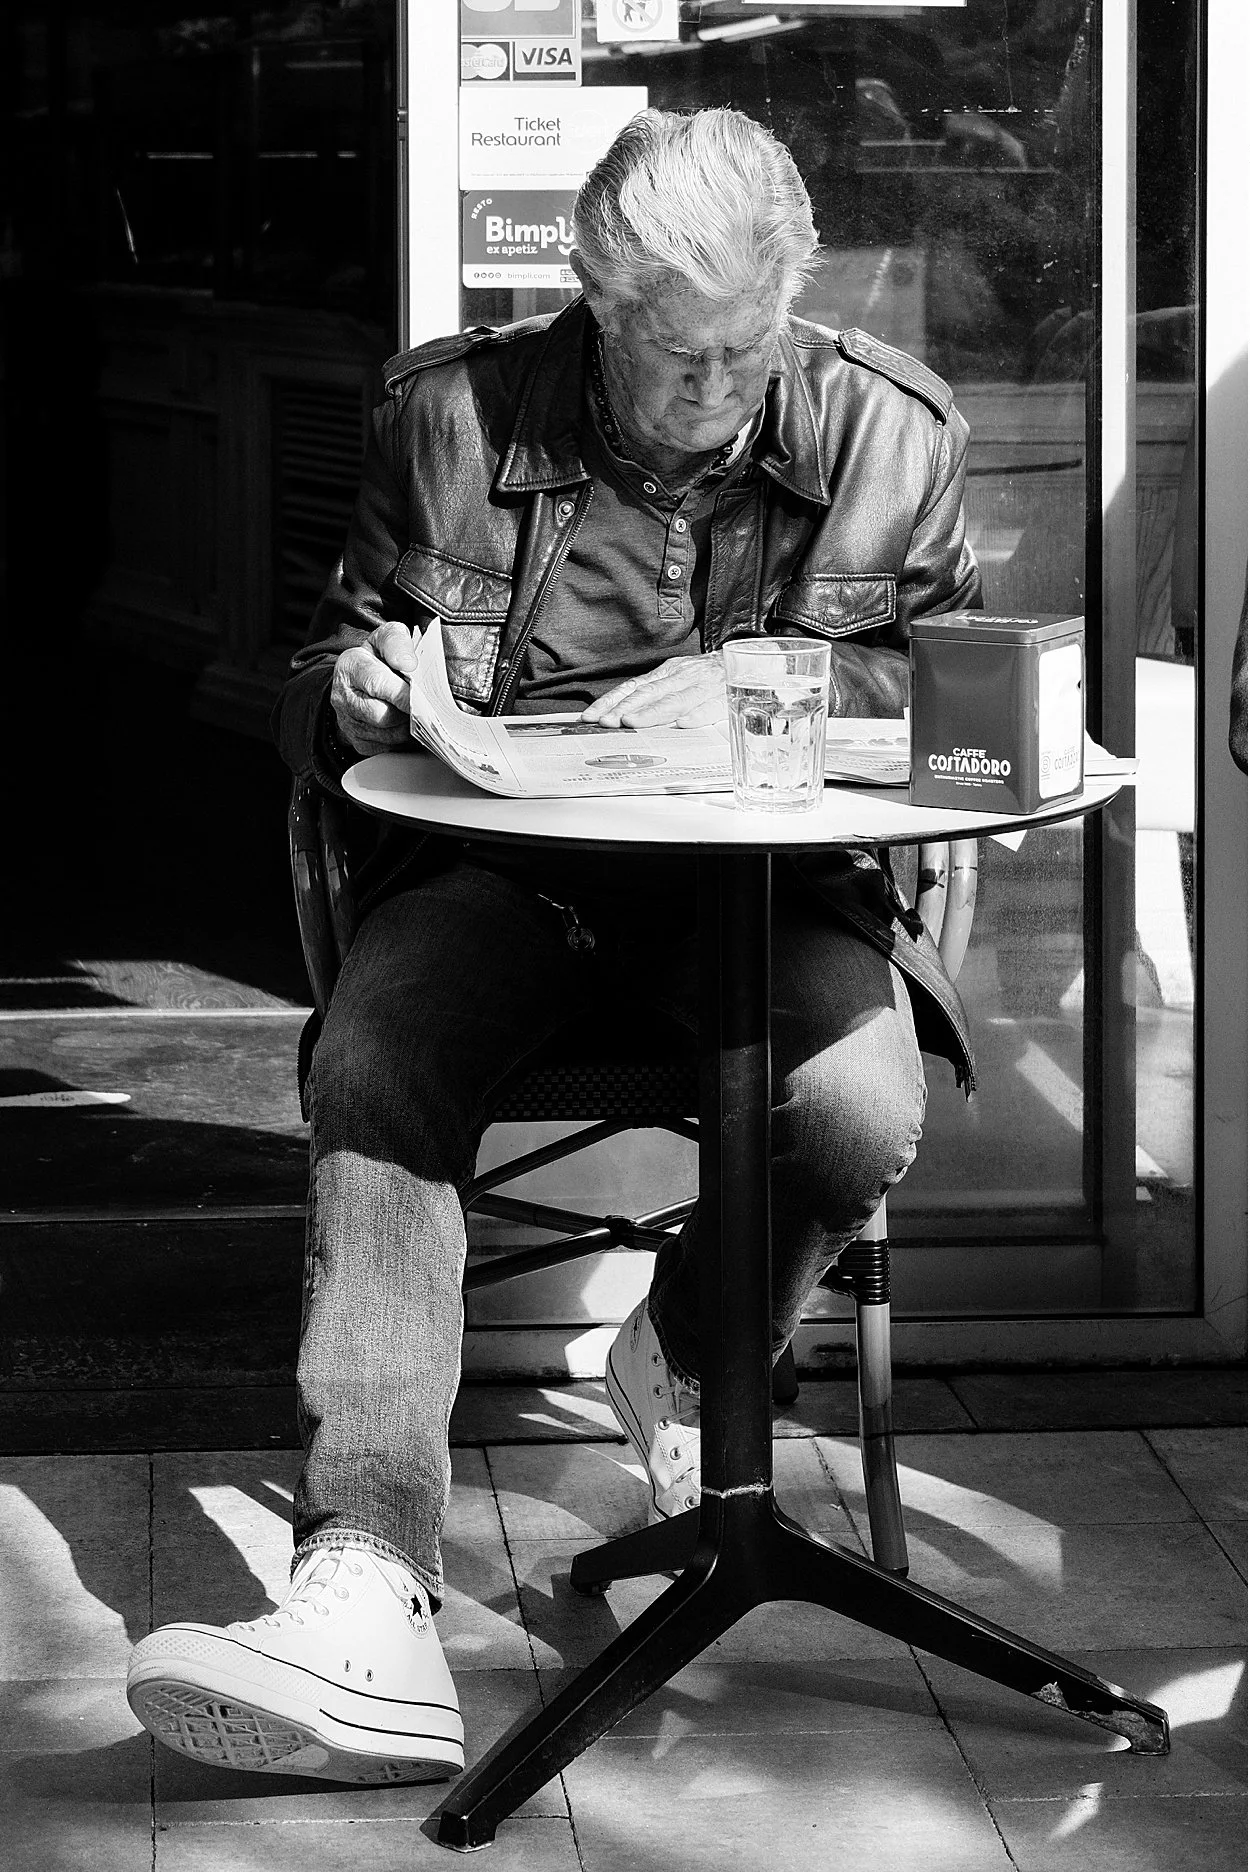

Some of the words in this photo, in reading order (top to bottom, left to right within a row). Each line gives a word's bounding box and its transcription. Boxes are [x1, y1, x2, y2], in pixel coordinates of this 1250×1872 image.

[522, 47, 573, 66] VISA
[514, 117, 561, 132] Ticket
[471, 132, 561, 147] Restaurant
[471, 198, 493, 219] RESTO
[486, 246, 500, 254] ex
[501, 244, 538, 256] apetiz
[507, 272, 551, 280] bimpli.com
[928, 754, 1011, 777] COSTADORO
